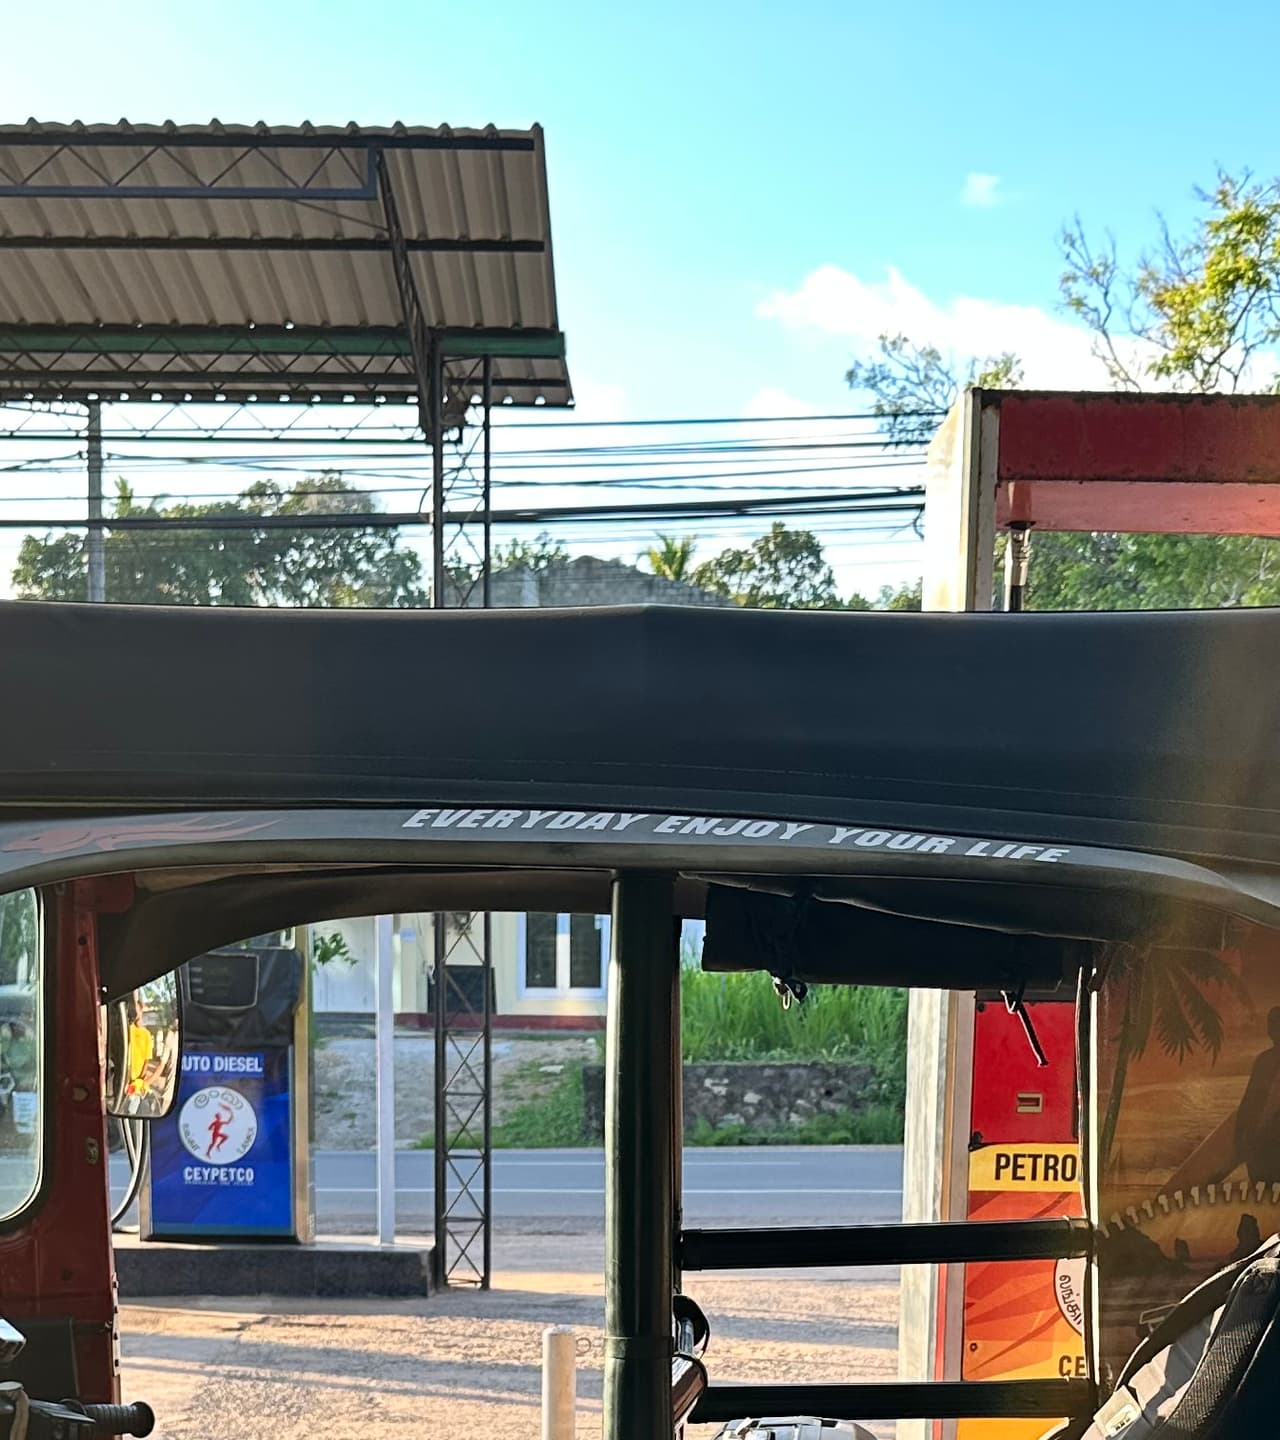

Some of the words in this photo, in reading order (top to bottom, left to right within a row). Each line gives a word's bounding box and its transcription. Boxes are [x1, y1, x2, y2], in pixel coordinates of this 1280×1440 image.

[402, 808, 648, 831] EVERYDAY
[653, 815, 814, 840] ENJOY
[827, 827, 956, 854] YOUR
[964, 841, 1070, 863] LIFE
[213, 1056, 263, 1073] DIESEL
[184, 1166, 254, 1182] CEYPETCO
[994, 1153, 1078, 1182] PETRO
